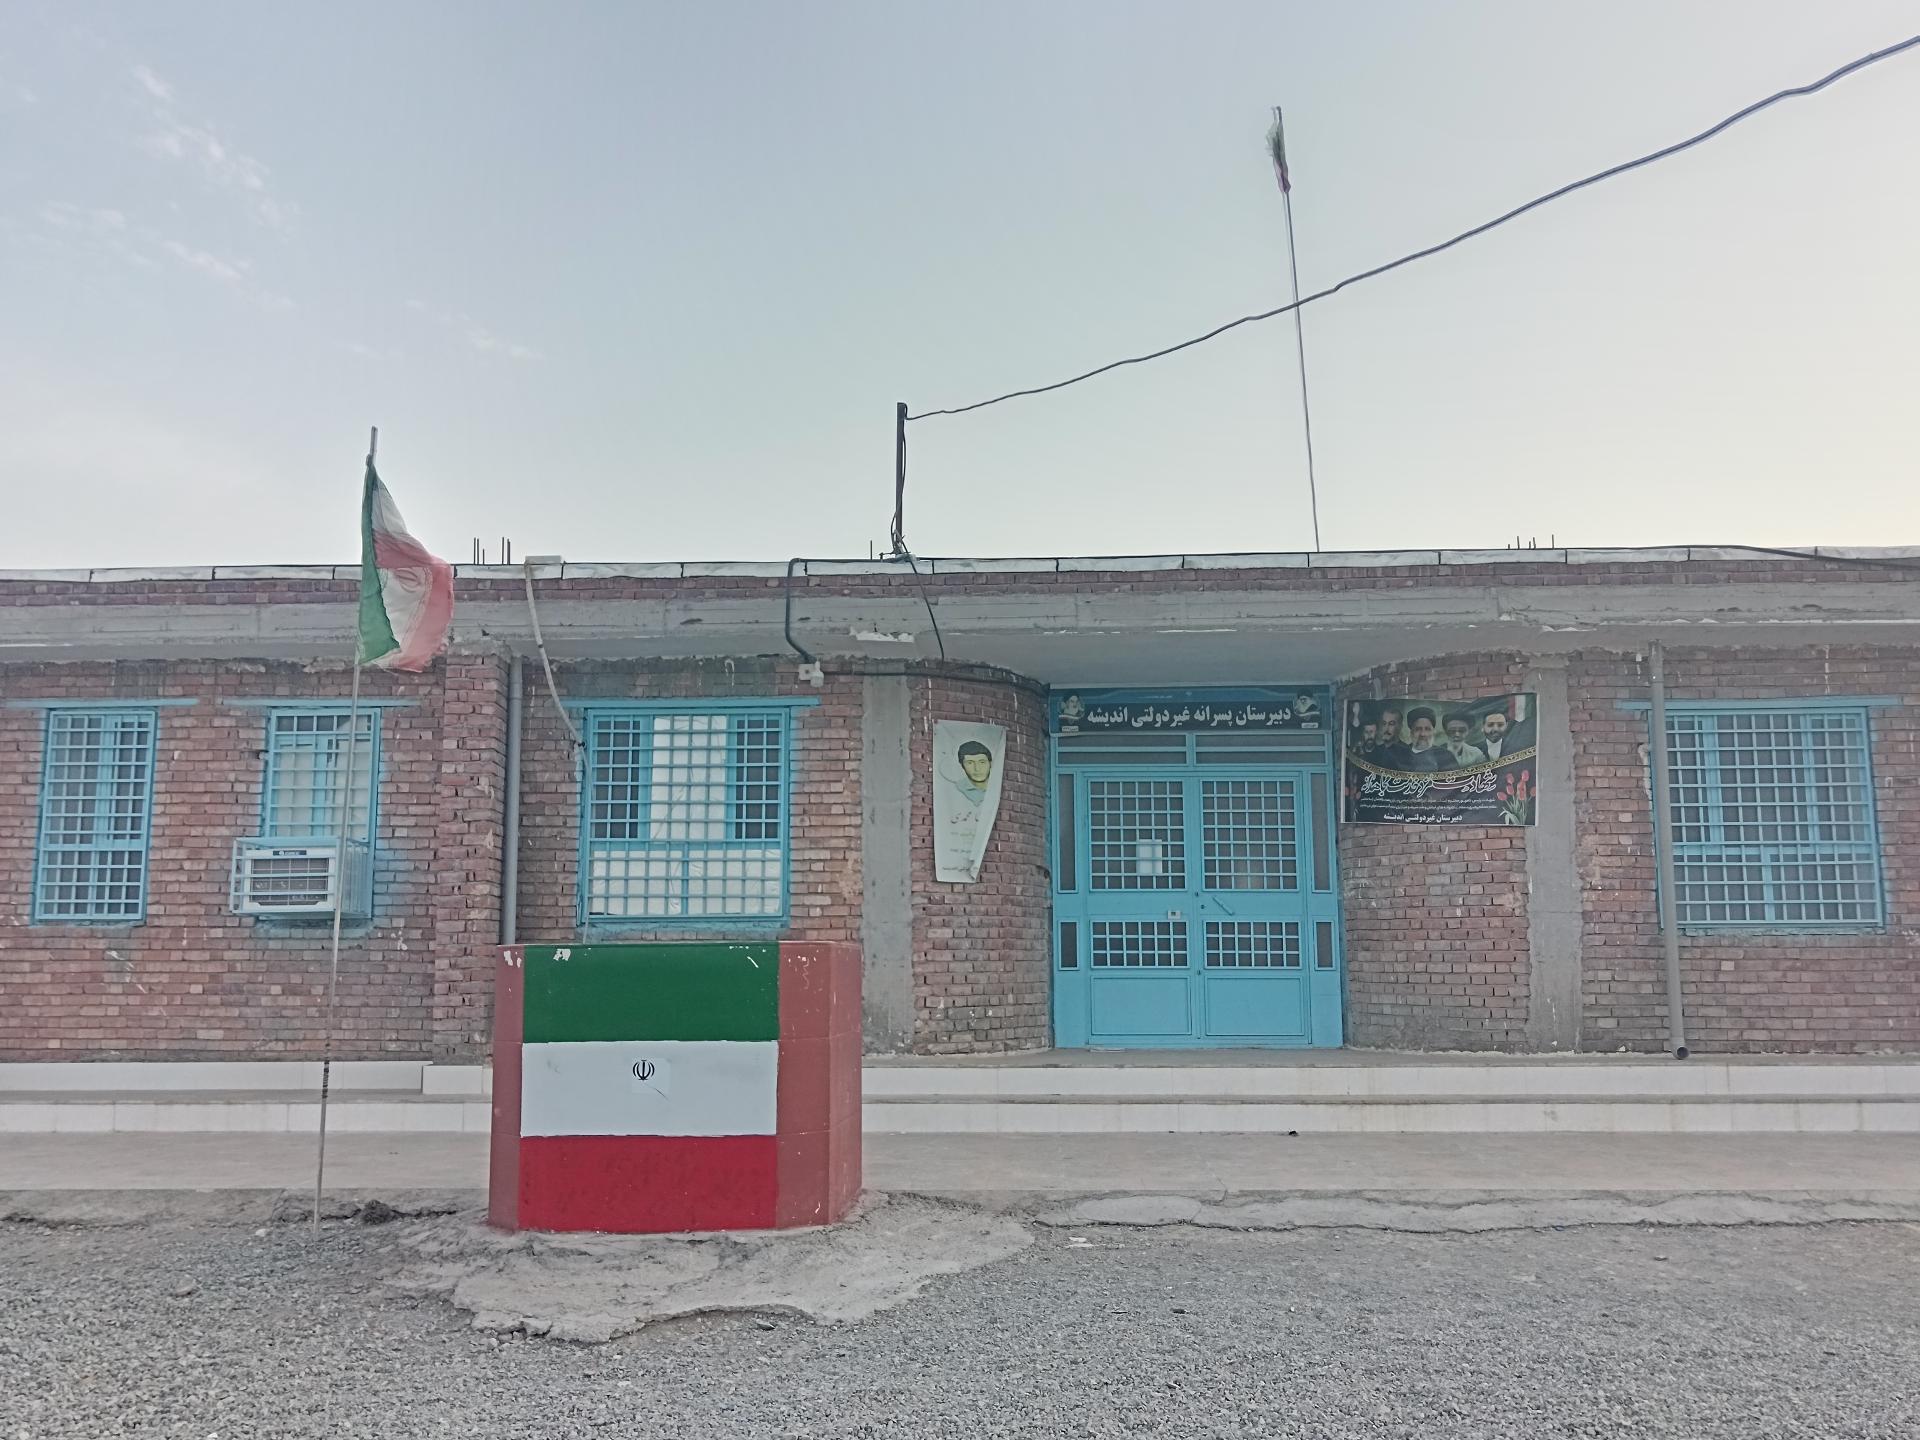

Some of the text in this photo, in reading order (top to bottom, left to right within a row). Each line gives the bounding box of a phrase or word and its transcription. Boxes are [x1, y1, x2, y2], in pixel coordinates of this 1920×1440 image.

[1087, 705, 1128, 724] اندیشه
[1193, 705, 1232, 727] پسرانه
[1235, 704, 1291, 726] دبیرستان
